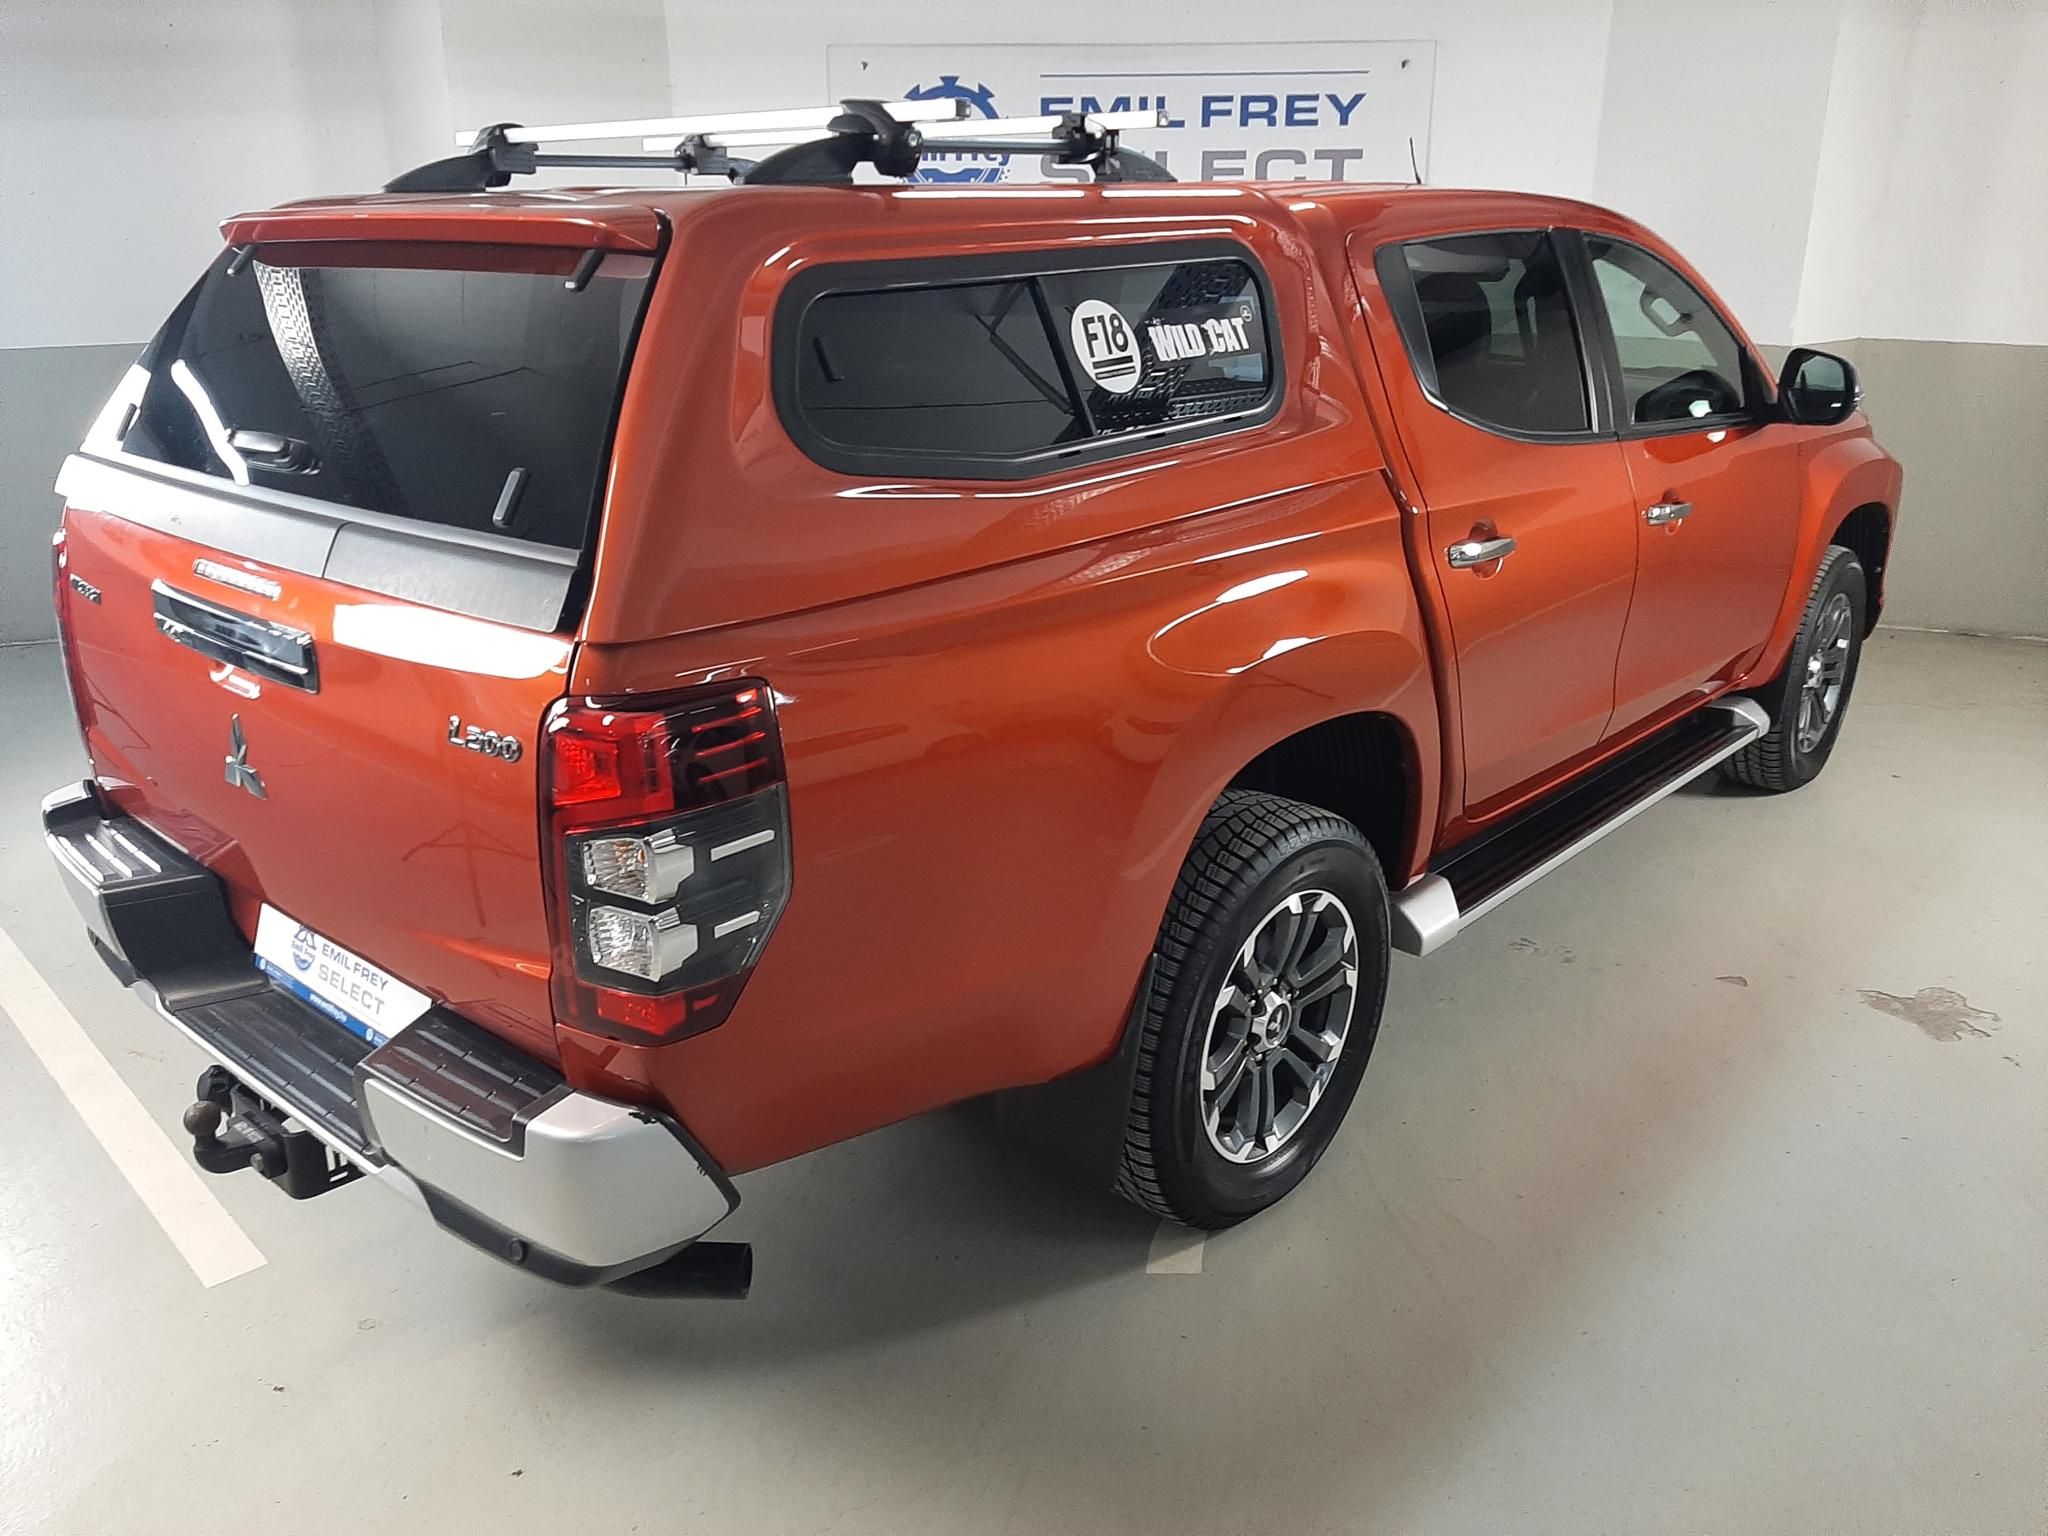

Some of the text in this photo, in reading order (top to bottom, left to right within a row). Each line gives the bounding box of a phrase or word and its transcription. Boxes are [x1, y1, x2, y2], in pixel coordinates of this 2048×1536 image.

[1201, 93, 1367, 128] FREY
[1081, 312, 1129, 358] F18
[1147, 322, 1206, 361] WILD
[448, 714, 523, 763] L200
[318, 963, 385, 1015] SELECT
[321, 943, 389, 991] EMIL FREY
